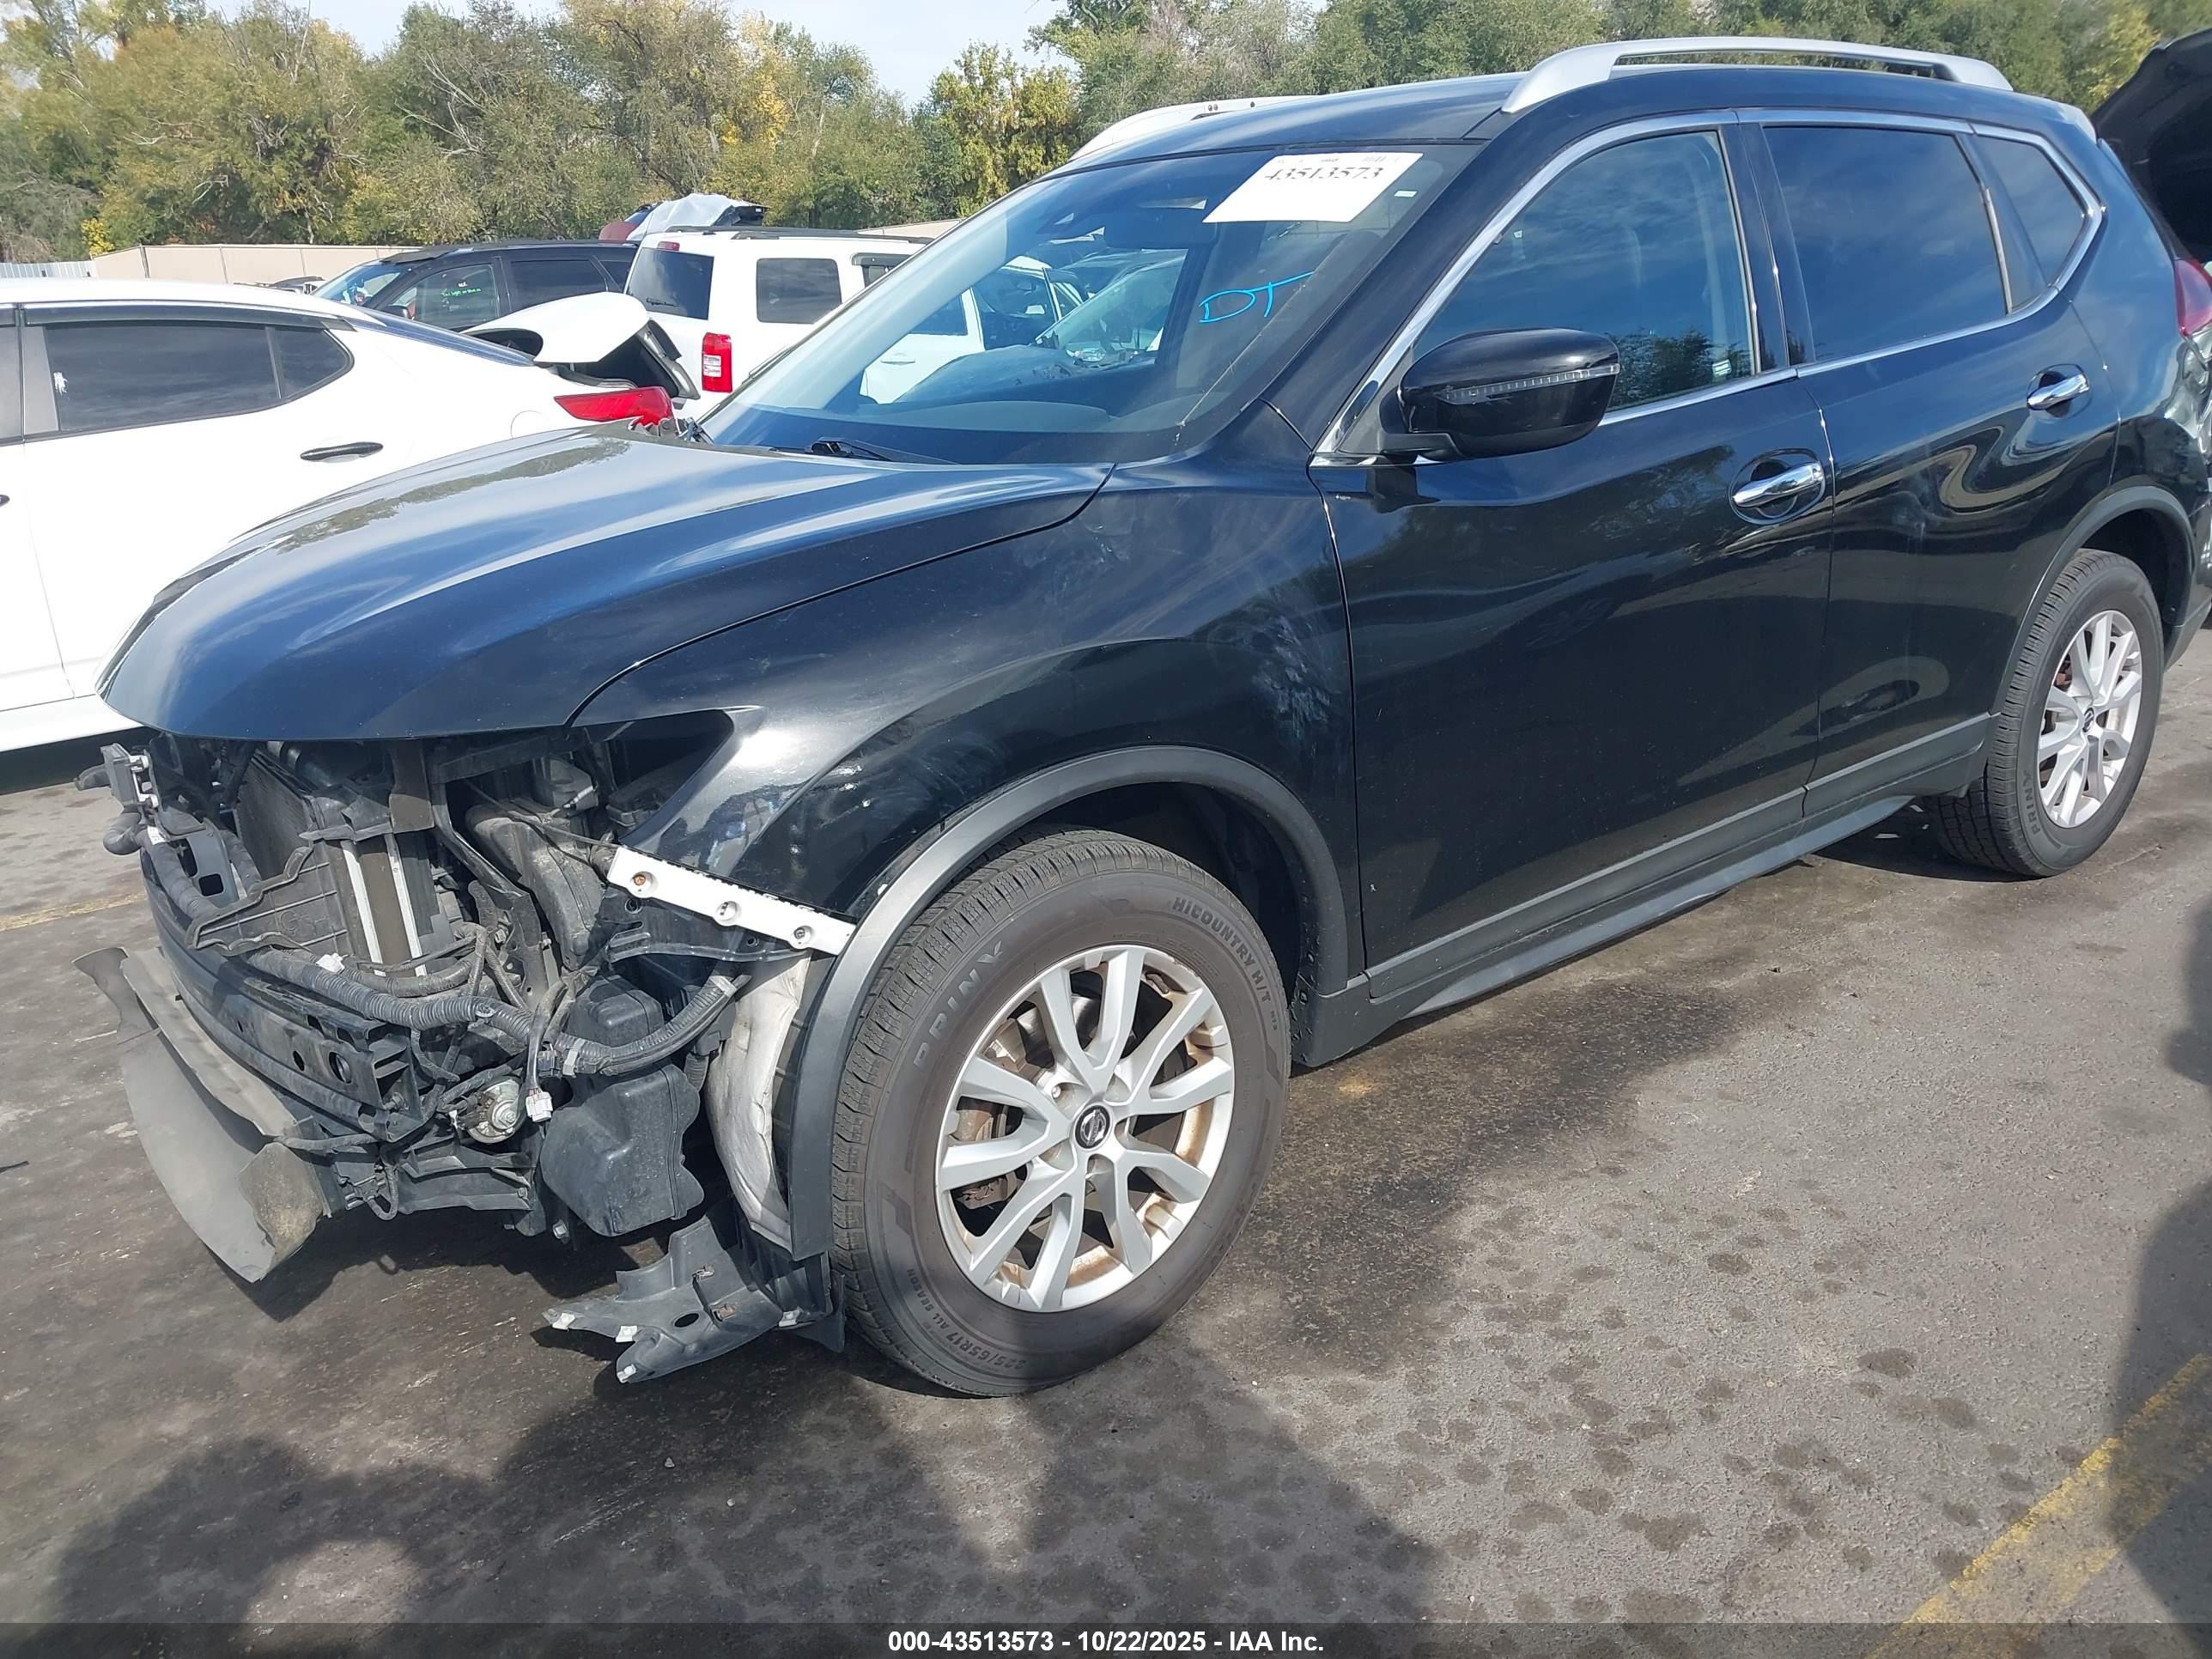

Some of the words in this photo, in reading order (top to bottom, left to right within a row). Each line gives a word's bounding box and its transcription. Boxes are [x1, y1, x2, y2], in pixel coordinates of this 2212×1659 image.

[1264, 167, 1384, 180] 43513573
[1199, 271, 1314, 324] DT
[1251, 969, 1272, 1003] H/T
[906, 1268, 934, 1311] SEASON
[932, 1312, 950, 1329] ALL
[945, 1332, 1027, 1370] 225/65R17
